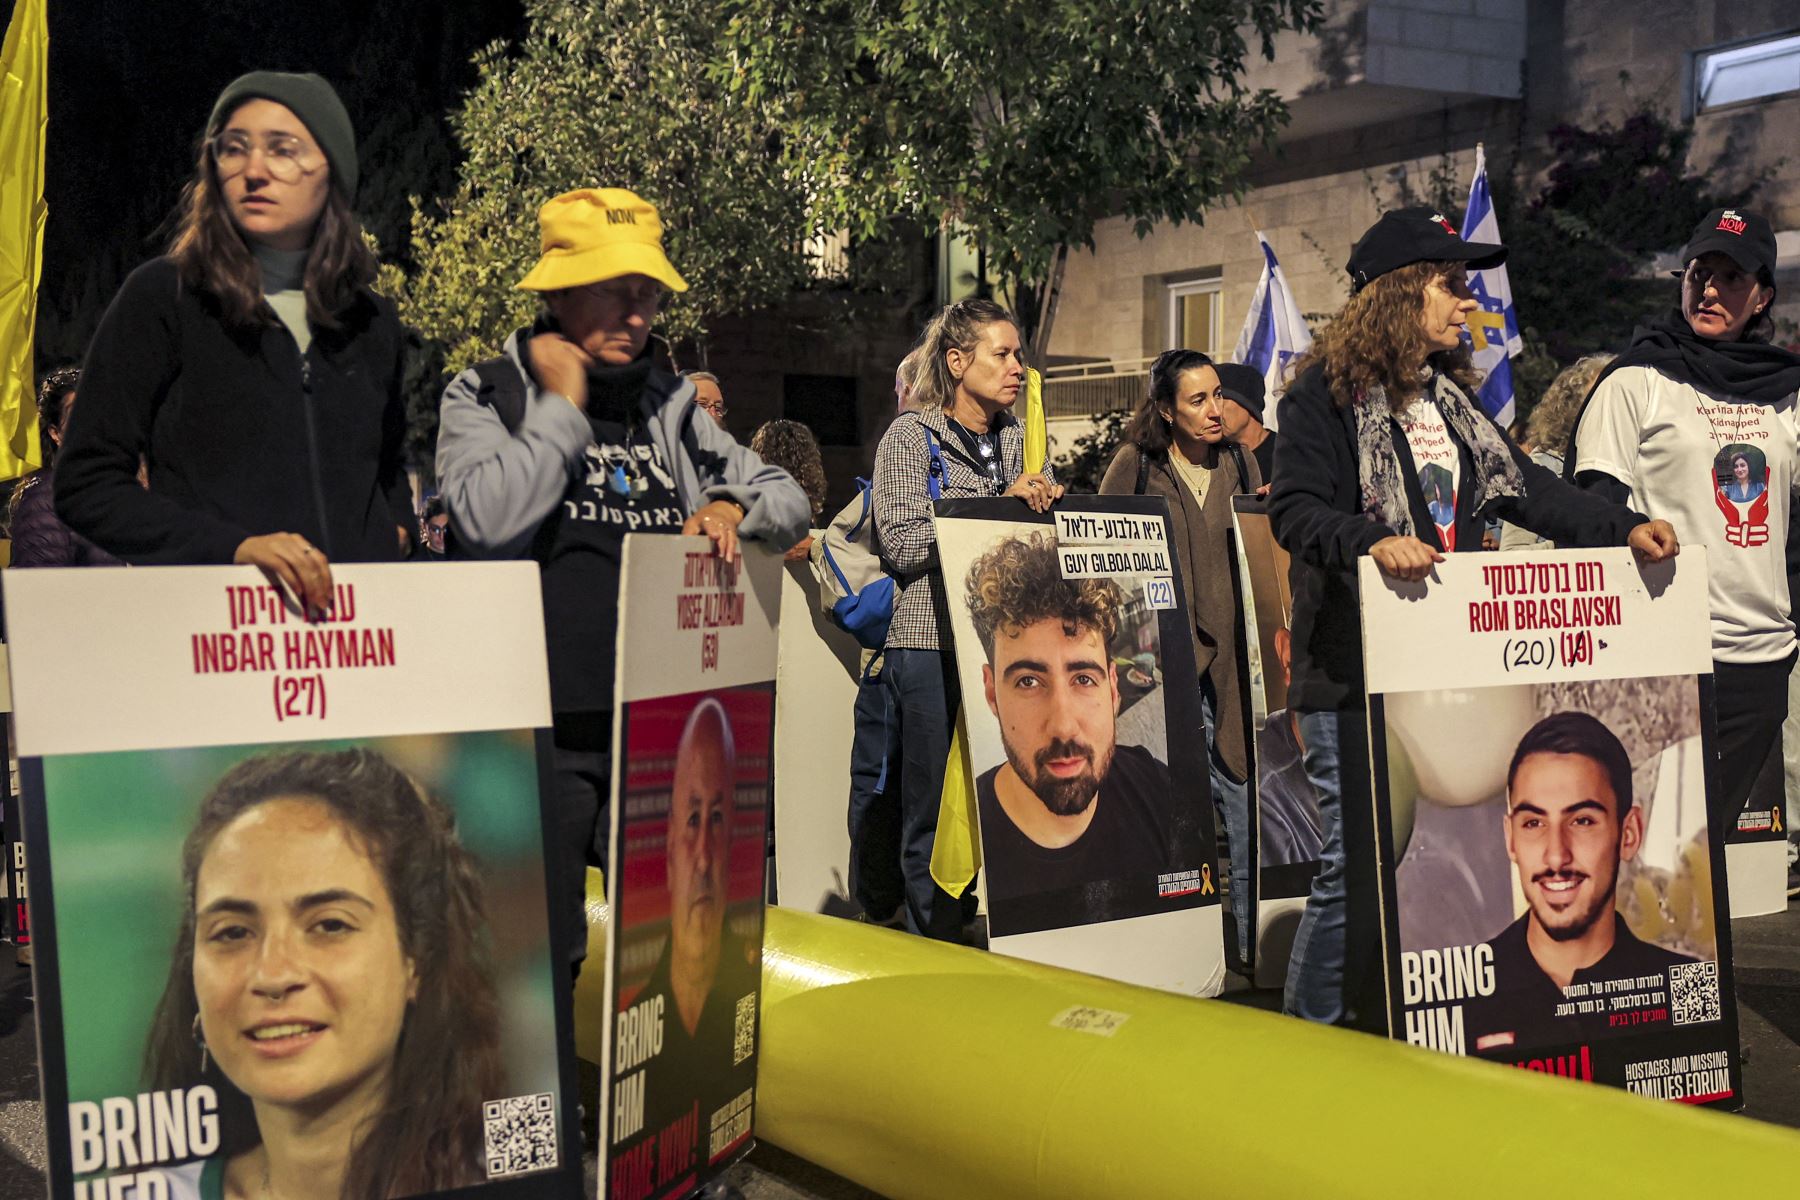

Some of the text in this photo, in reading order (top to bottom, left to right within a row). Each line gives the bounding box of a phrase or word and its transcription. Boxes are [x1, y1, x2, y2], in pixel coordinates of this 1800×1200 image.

[605, 208, 636, 225] NOW
[1718, 218, 1747, 232] NOW
[1696, 404, 1765, 416] Karina Ariev
[1711, 418, 1760, 429] Kidnapped
[1737, 431, 1769, 441] קרינה
[1061, 514, 1163, 541] גיא גלבוע-דלאל
[1064, 552, 1168, 573] GUY GILBOA DALAL
[1147, 581, 1173, 608] (22)
[1482, 561, 1604, 599] רום ברסלבסקי
[226, 585, 287, 630] הימן
[1469, 596, 1622, 632] ROM BRASLAVSKI
[191, 628, 396, 674] INBAR HAYMAN
[1503, 637, 1555, 672] (20)
[273, 673, 326, 722] (27)
[1401, 943, 1496, 1005] BRING
[1590, 981, 1603, 994] של
[1652, 991, 1666, 1004] רום
[616, 993, 664, 1075] BRING
[1405, 1005, 1466, 1057] HIM
[1625, 1050, 1728, 1081] HOSTAGES AND MISSING
[1685, 1068, 1730, 1098] FORUM
[613, 1069, 645, 1145] HIM
[68, 1085, 220, 1174] BRING
